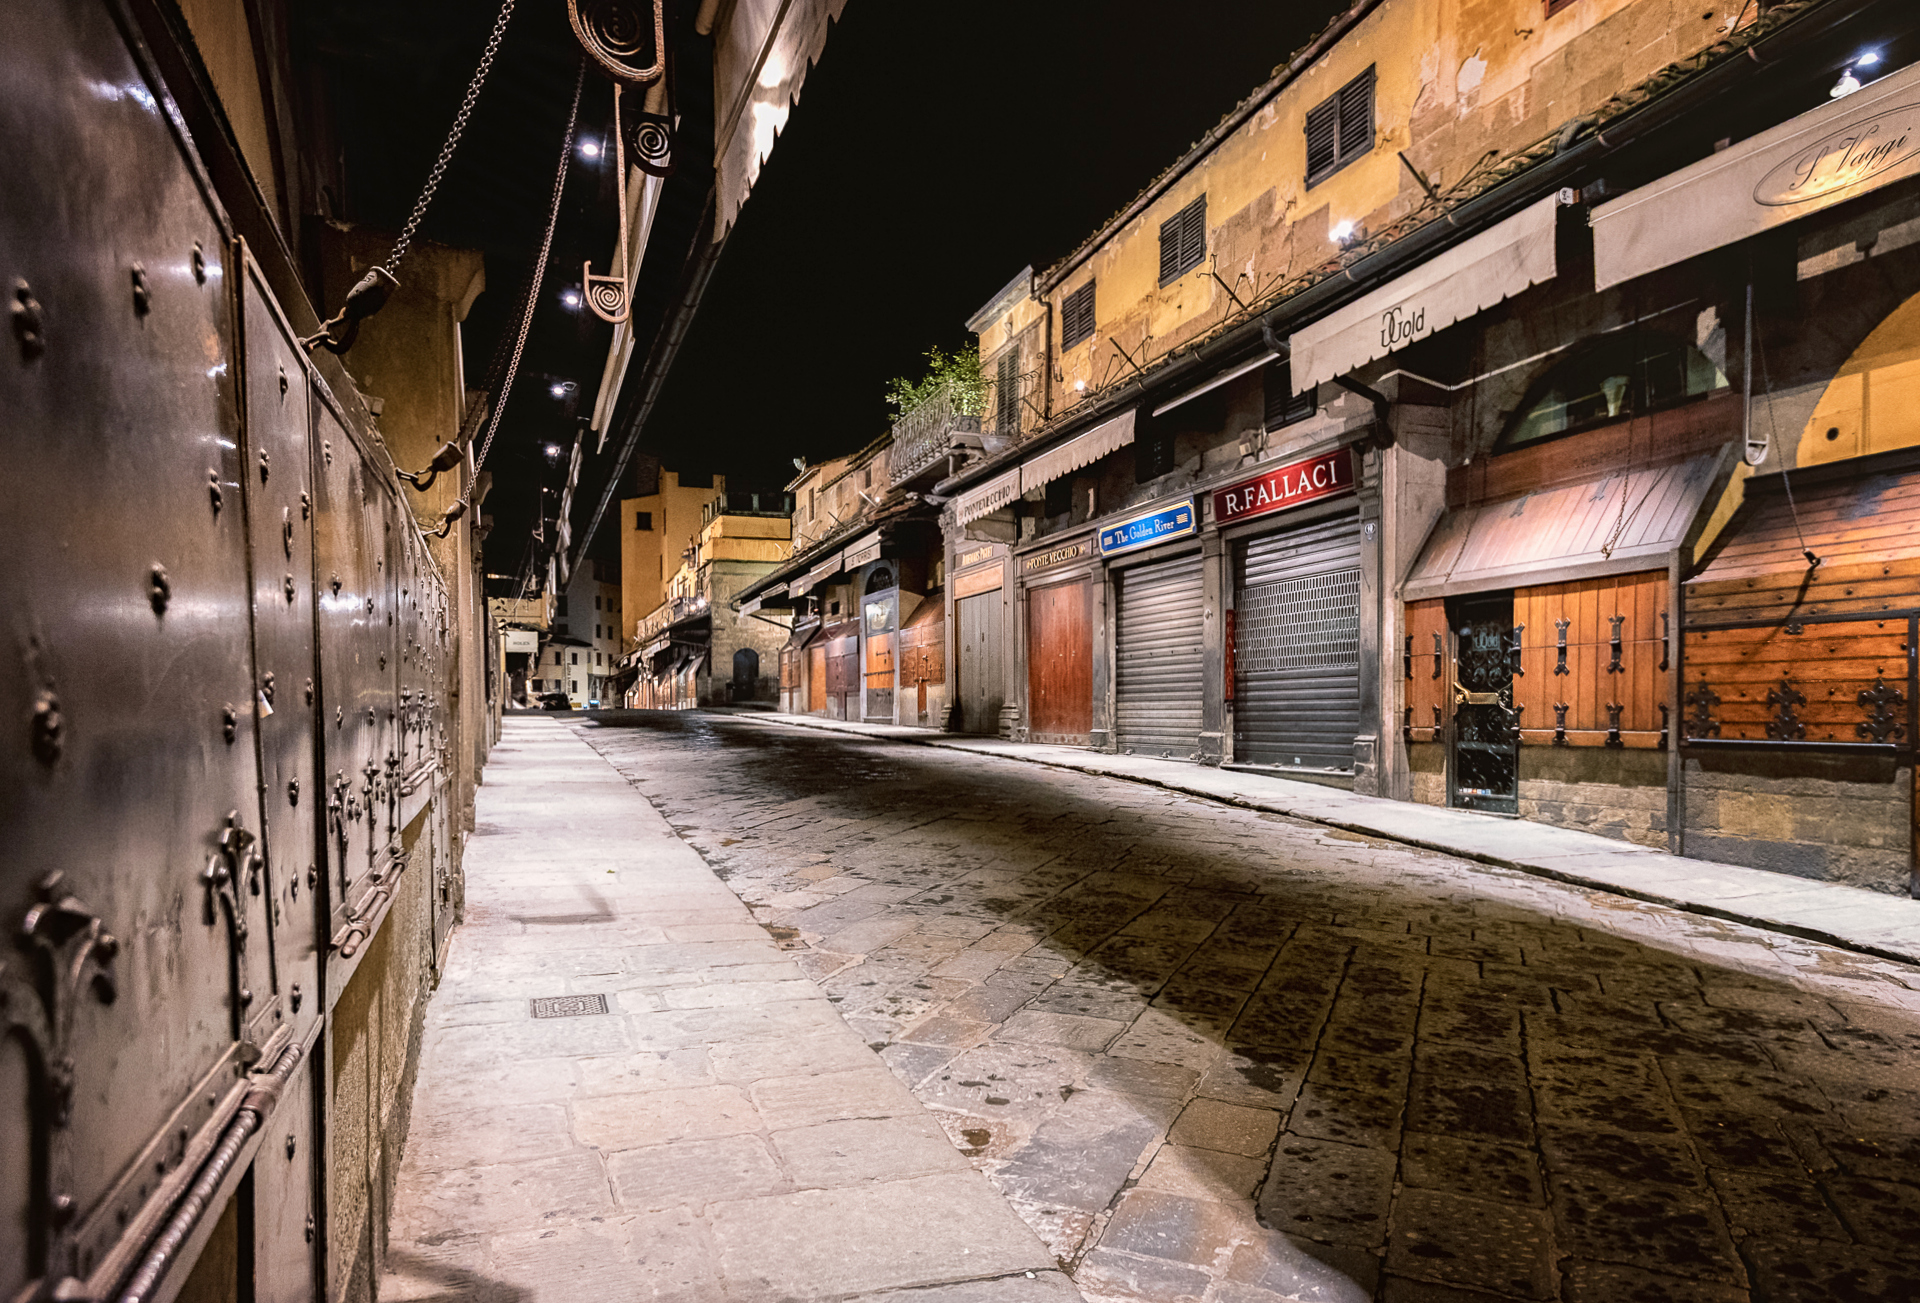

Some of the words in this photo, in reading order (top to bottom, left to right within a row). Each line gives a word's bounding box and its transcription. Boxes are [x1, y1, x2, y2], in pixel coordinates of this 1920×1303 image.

[1838, 124, 1912, 176] Vaggi
[1115, 529, 1129, 545] The
[1129, 523, 1154, 540] Golden
[1154, 518, 1175, 534] River
[1030, 553, 1049, 570] PONTE
[1049, 545, 1078, 565] VECCHIO
